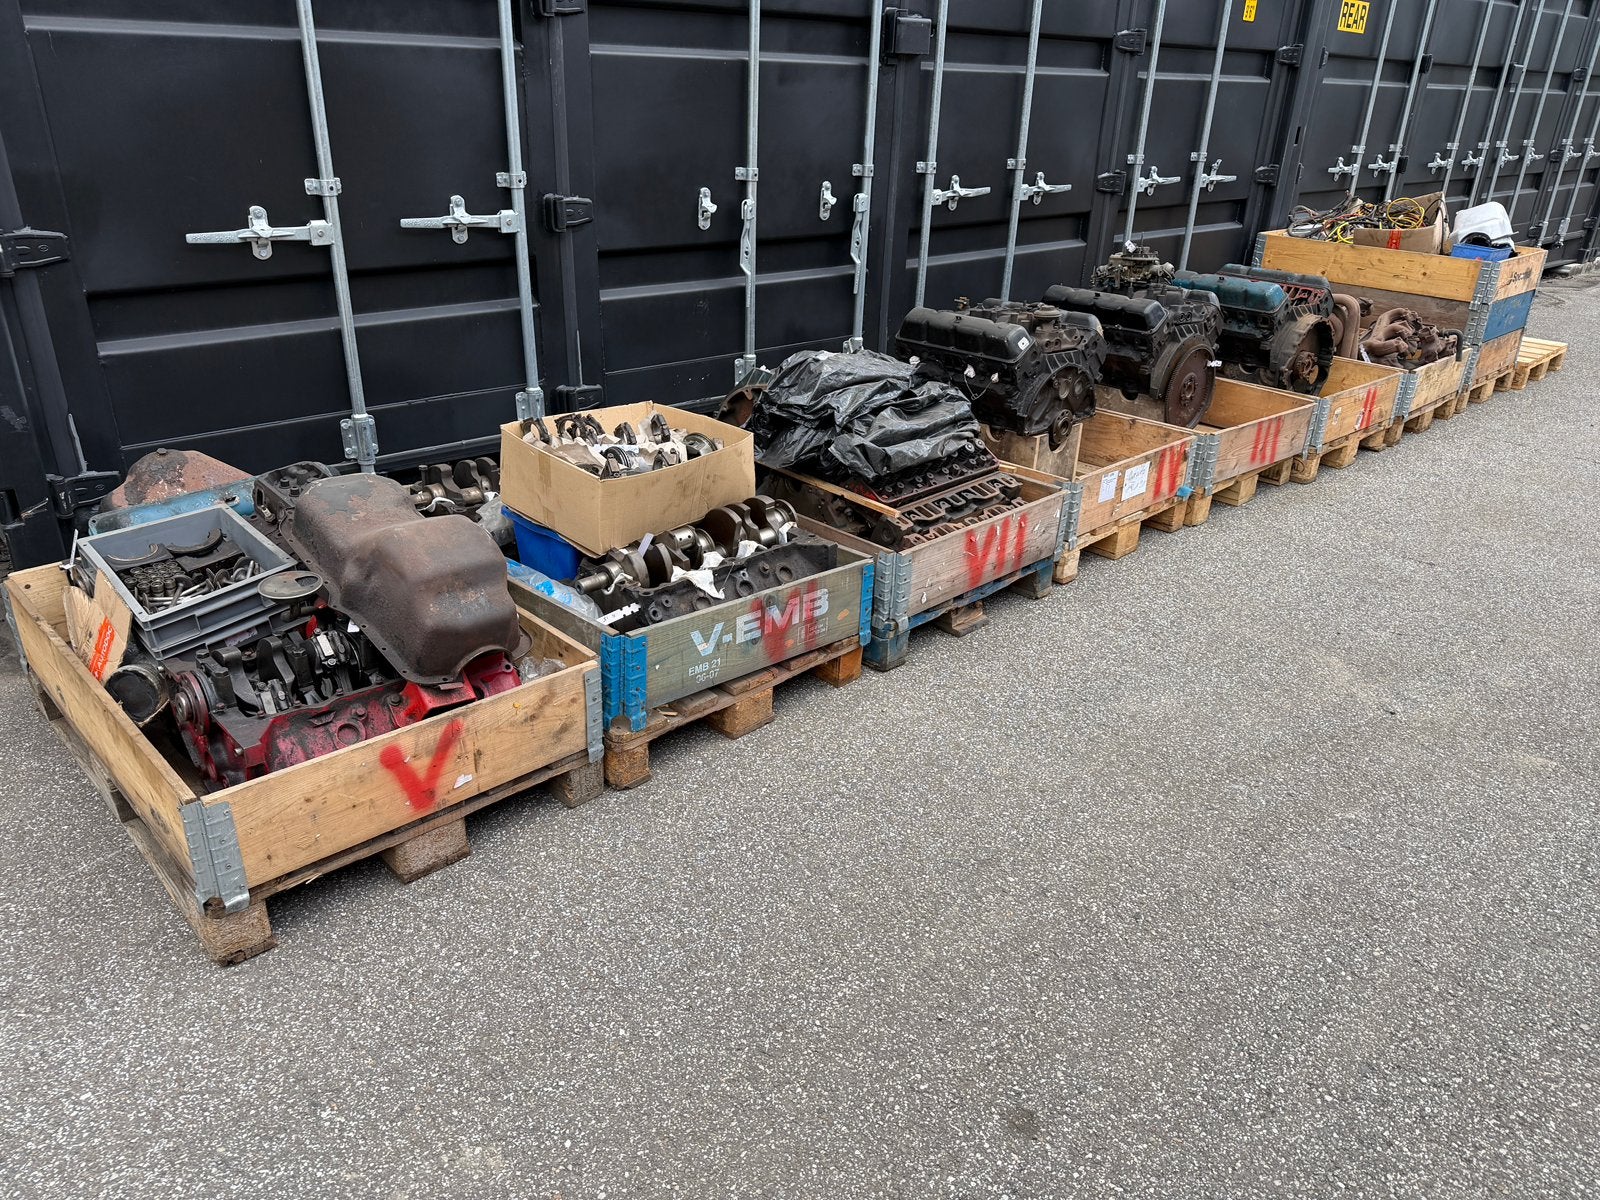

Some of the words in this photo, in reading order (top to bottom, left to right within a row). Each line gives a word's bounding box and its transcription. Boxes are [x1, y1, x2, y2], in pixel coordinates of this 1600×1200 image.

[1339, 2, 1367, 29] REAR
[1250, 415, 1284, 464] III
[1153, 442, 1188, 500] IV
[965, 512, 1028, 589] VII
[688, 660, 710, 677] EMB
[711, 658, 721, 668] 21
[380, 718, 464, 811] V
